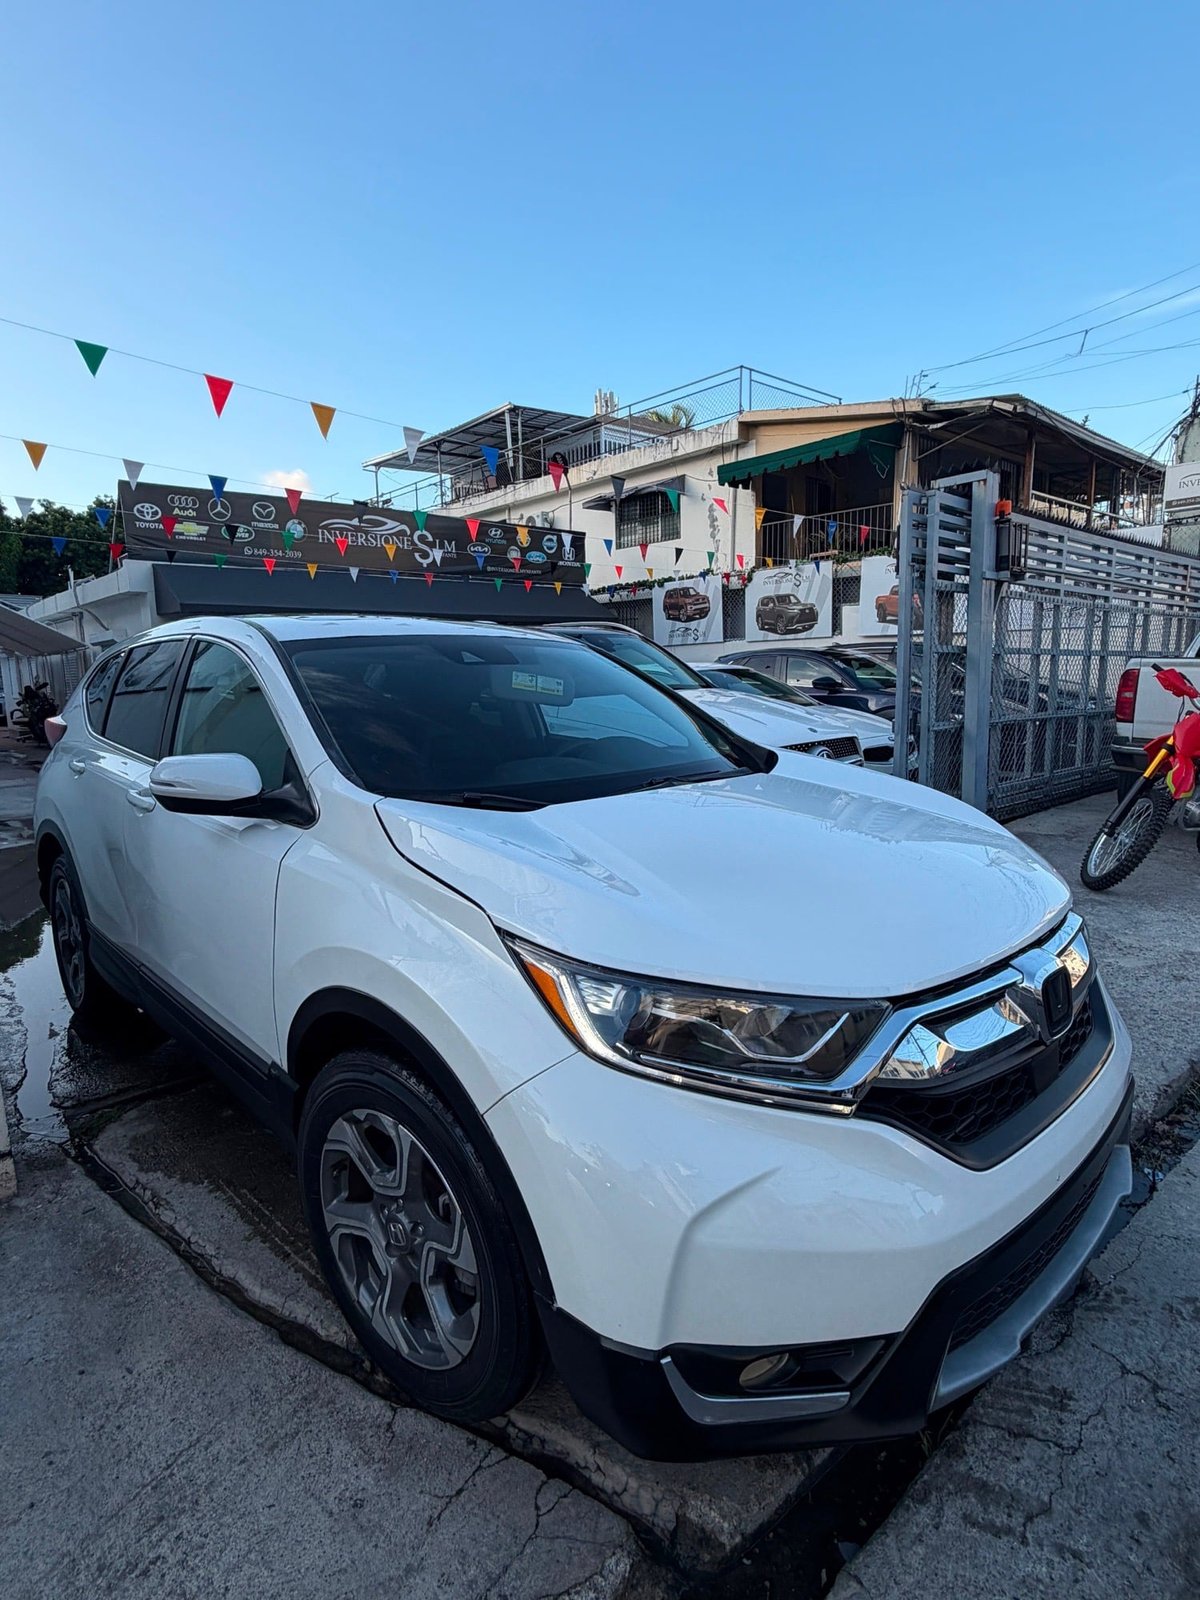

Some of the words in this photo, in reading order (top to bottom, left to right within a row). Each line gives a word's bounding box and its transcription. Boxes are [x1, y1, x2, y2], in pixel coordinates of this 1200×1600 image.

[172, 507, 197, 517] Audi
[134, 521, 165, 530] TOYOTA
[175, 534, 207, 542] CHEVROLET
[253, 548, 302, 559] 849-354-2039
